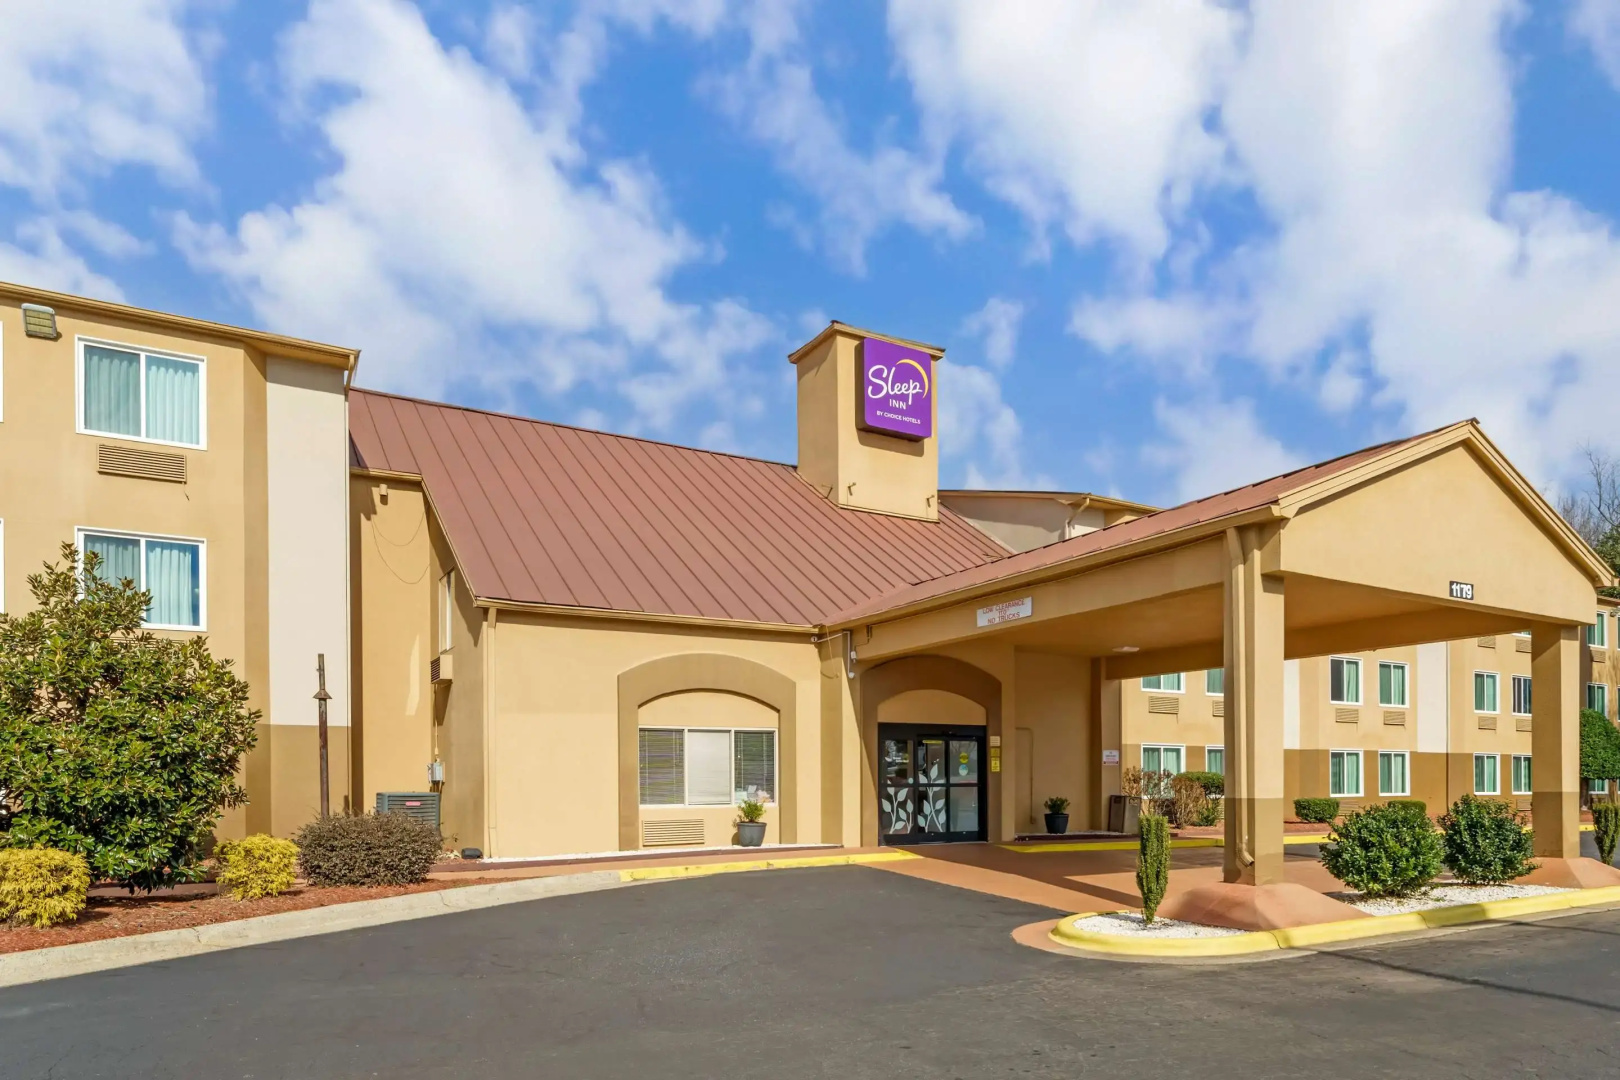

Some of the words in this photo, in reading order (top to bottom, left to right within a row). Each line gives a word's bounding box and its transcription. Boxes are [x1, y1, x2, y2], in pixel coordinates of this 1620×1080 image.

[868, 365, 922, 405] Sleep
[890, 399, 906, 410] INN
[884, 411, 902, 420] CHOICE
[902, 416, 921, 424] HOTELS
[1451, 582, 1472, 599] 1179
[996, 599, 1024, 611] CLEARANCE
[999, 612, 1020, 622] TRUCKS
